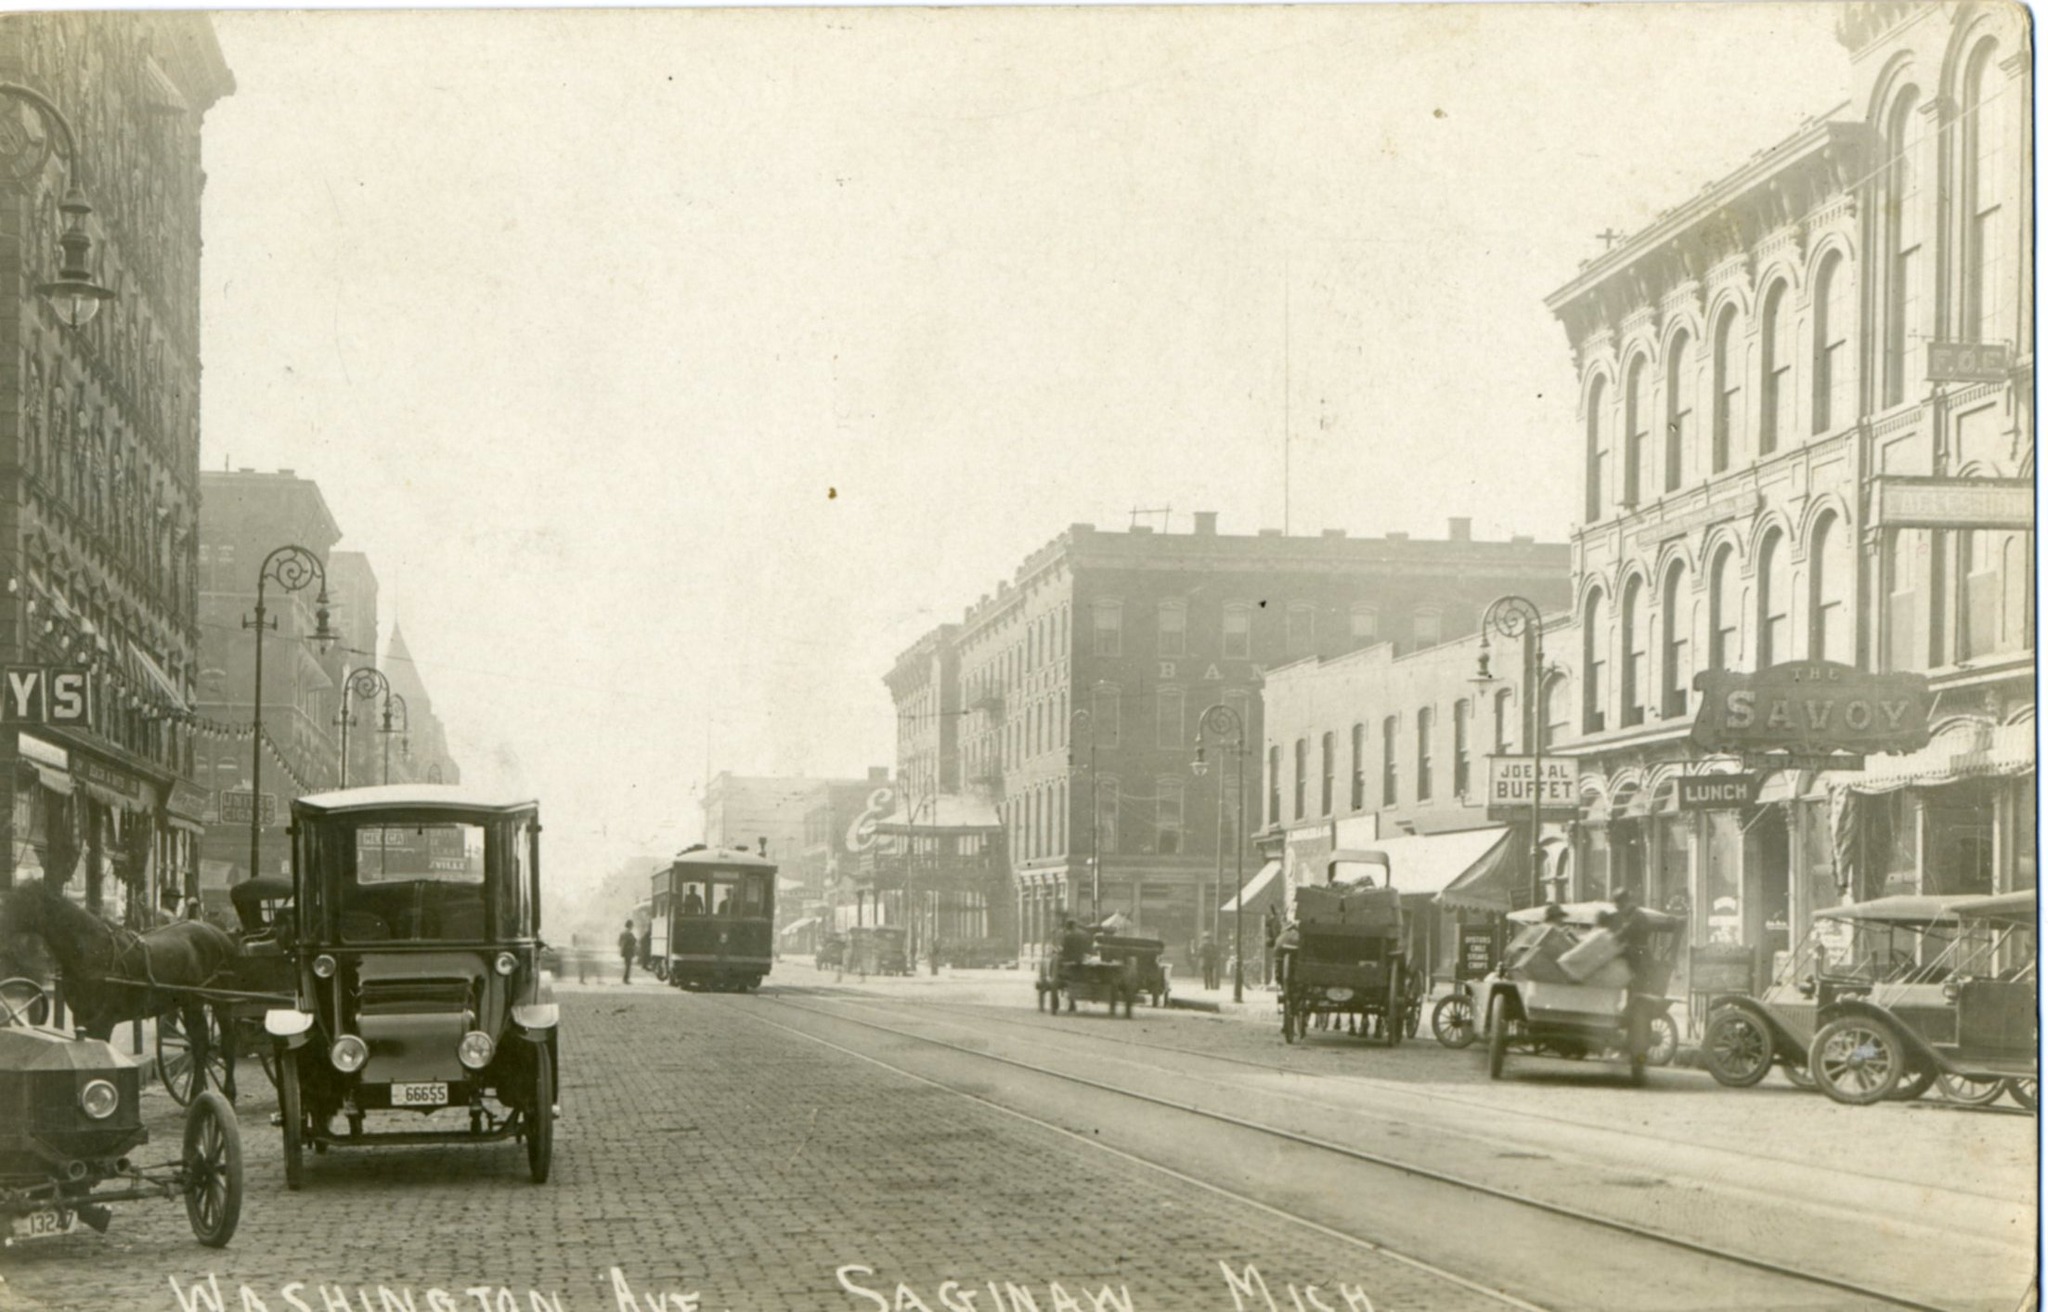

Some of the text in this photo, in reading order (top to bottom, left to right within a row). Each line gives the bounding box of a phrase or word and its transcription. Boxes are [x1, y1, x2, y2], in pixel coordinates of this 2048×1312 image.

[1791, 667, 1839, 680] THE
[7, 671, 83, 718] YS
[1726, 690, 1908, 730] SAVOY
[1500, 765, 1532, 778] JOE
[1548, 765, 1568, 778] AL
[1497, 781, 1573, 798] BUFFET
[1686, 784, 1748, 801] LUNCH
[405, 1086, 446, 1101] 66655
